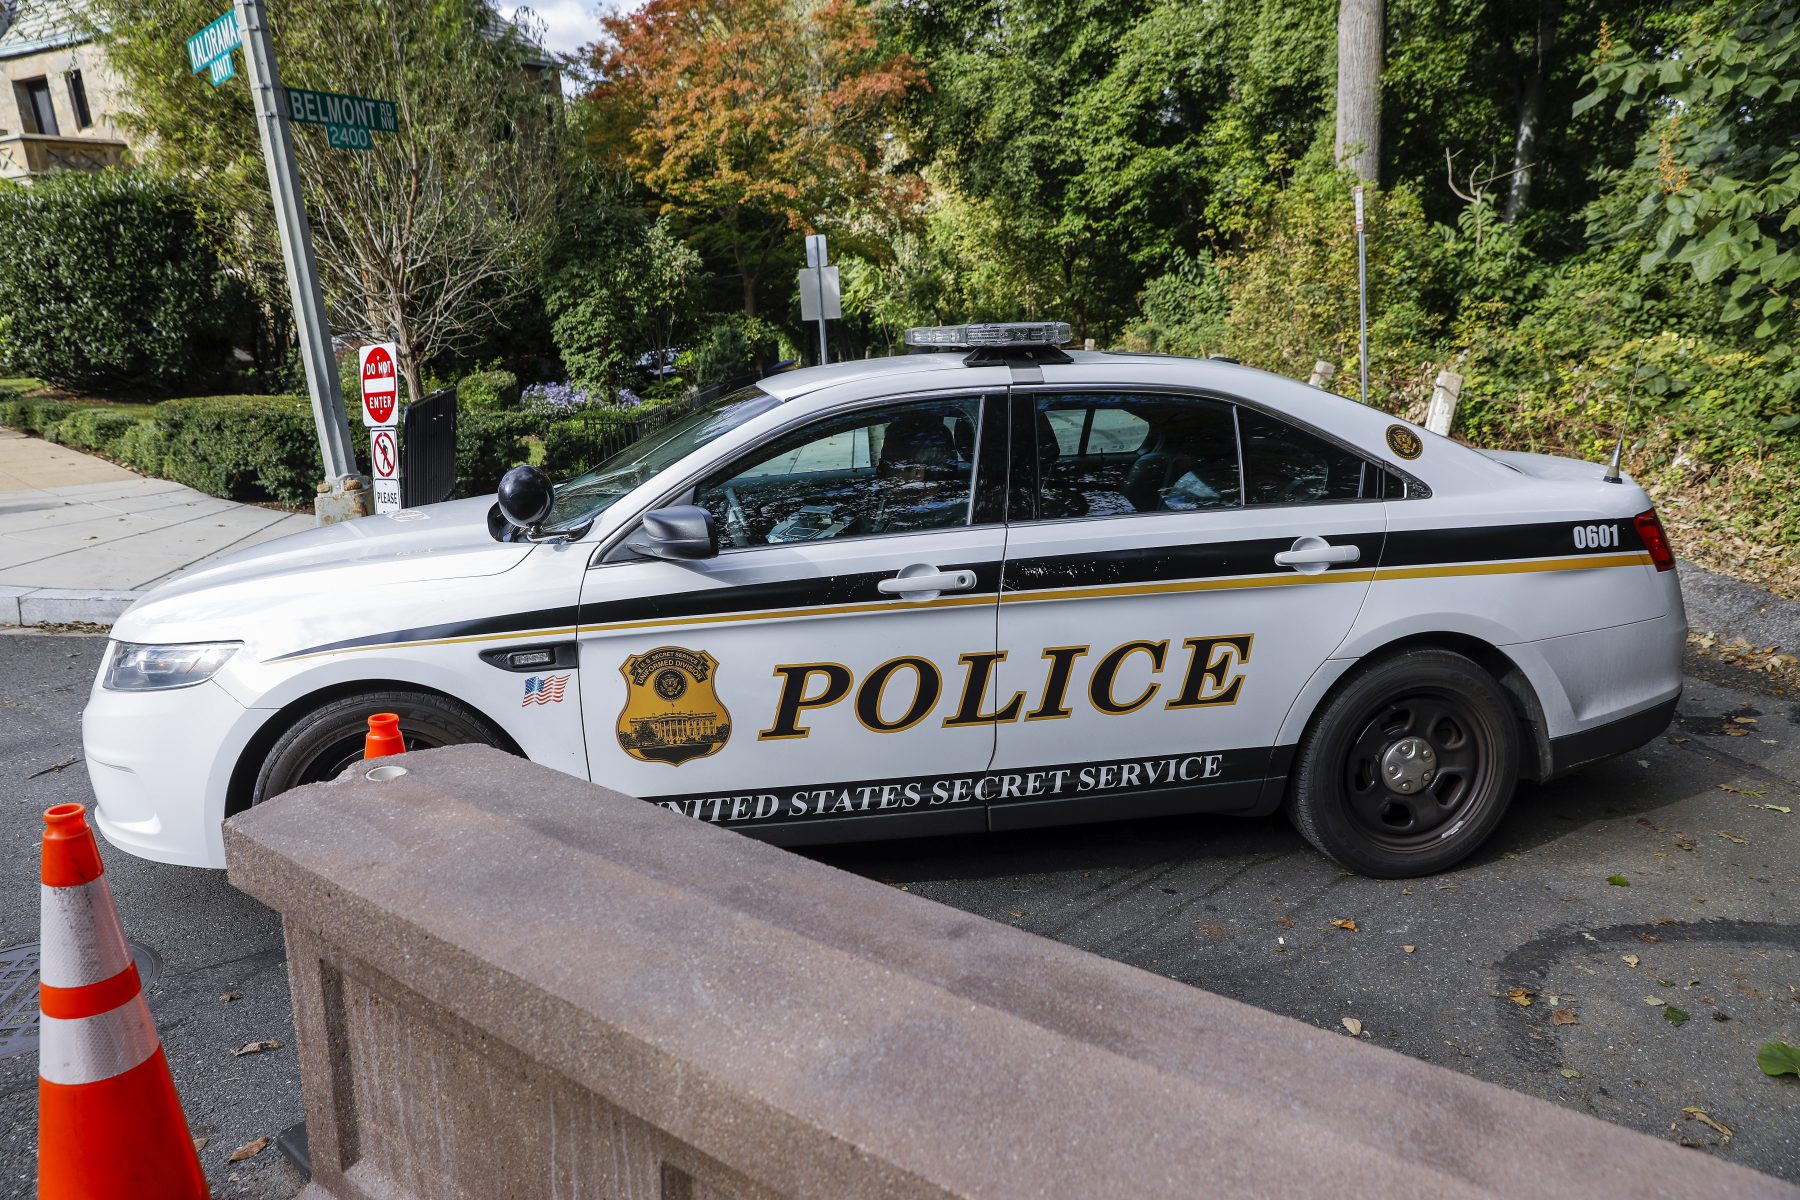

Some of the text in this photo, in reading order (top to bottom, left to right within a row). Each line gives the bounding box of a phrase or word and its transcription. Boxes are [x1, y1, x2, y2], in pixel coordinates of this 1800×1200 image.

[189, 15, 238, 70] KALORAMA
[211, 54, 231, 82] UNIT
[290, 91, 375, 127] BELMONT
[380, 103, 392, 116] RD
[381, 116, 395, 130] NW
[329, 126, 368, 147] 2400
[366, 361, 391, 376] DO NOT
[369, 396, 392, 409] ENTER
[377, 491, 398, 504] PLEASE
[1573, 524, 1619, 549] 0601
[651, 652, 674, 660] SECRET
[675, 652, 698, 664] SERVICE
[638, 659, 703, 684] UNIFORMED DIVISION
[757, 633, 1255, 741] POLICE
[656, 754, 1223, 822] NITED STATES SECRET SERVICE
